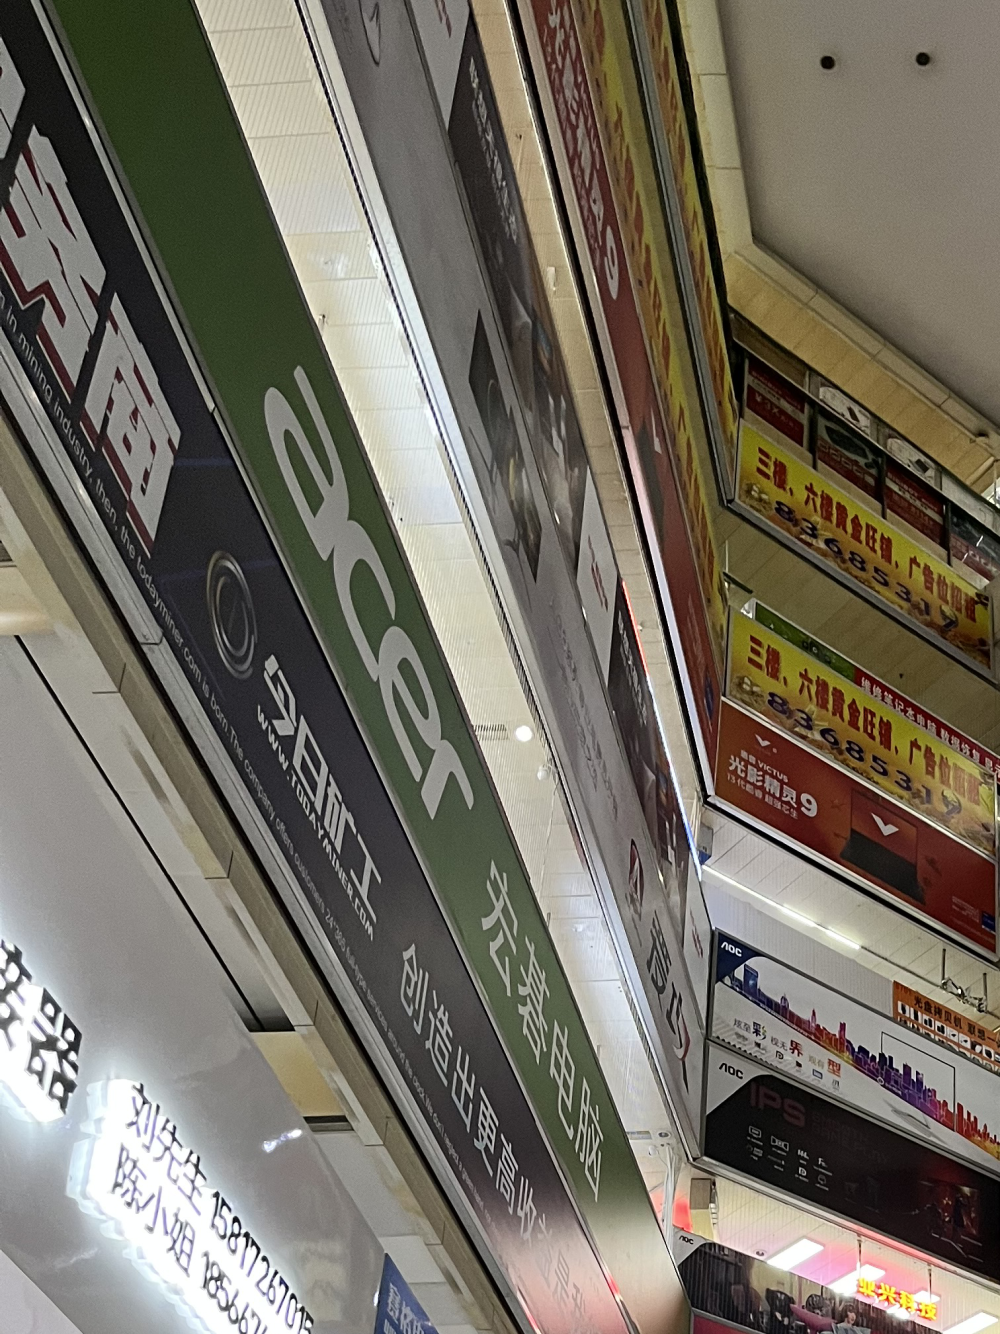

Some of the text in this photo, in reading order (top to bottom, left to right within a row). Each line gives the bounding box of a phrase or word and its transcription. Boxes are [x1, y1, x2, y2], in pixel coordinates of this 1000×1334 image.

[0, 38, 182, 560] 务商
[15, 329, 57, 403] mining
[49, 397, 99, 484] industry,
[92, 477, 123, 531] then,
[119, 524, 137, 559] the
[134, 555, 202, 683] todayminer.com
[242, 757, 275, 820] company
[263, 365, 474, 820] acer
[257, 705, 377, 942] WWW.TODAYMINER.COM
[757, 760, 789, 783] VICTUS
[481, 859, 603, 1203] 宏碁电脑
[720, 941, 743, 958] AOC
[127, 1081, 207, 1218] 刘先生
[718, 1062, 744, 1081] AOC
[112, 1141, 196, 1278] 陈小姐
